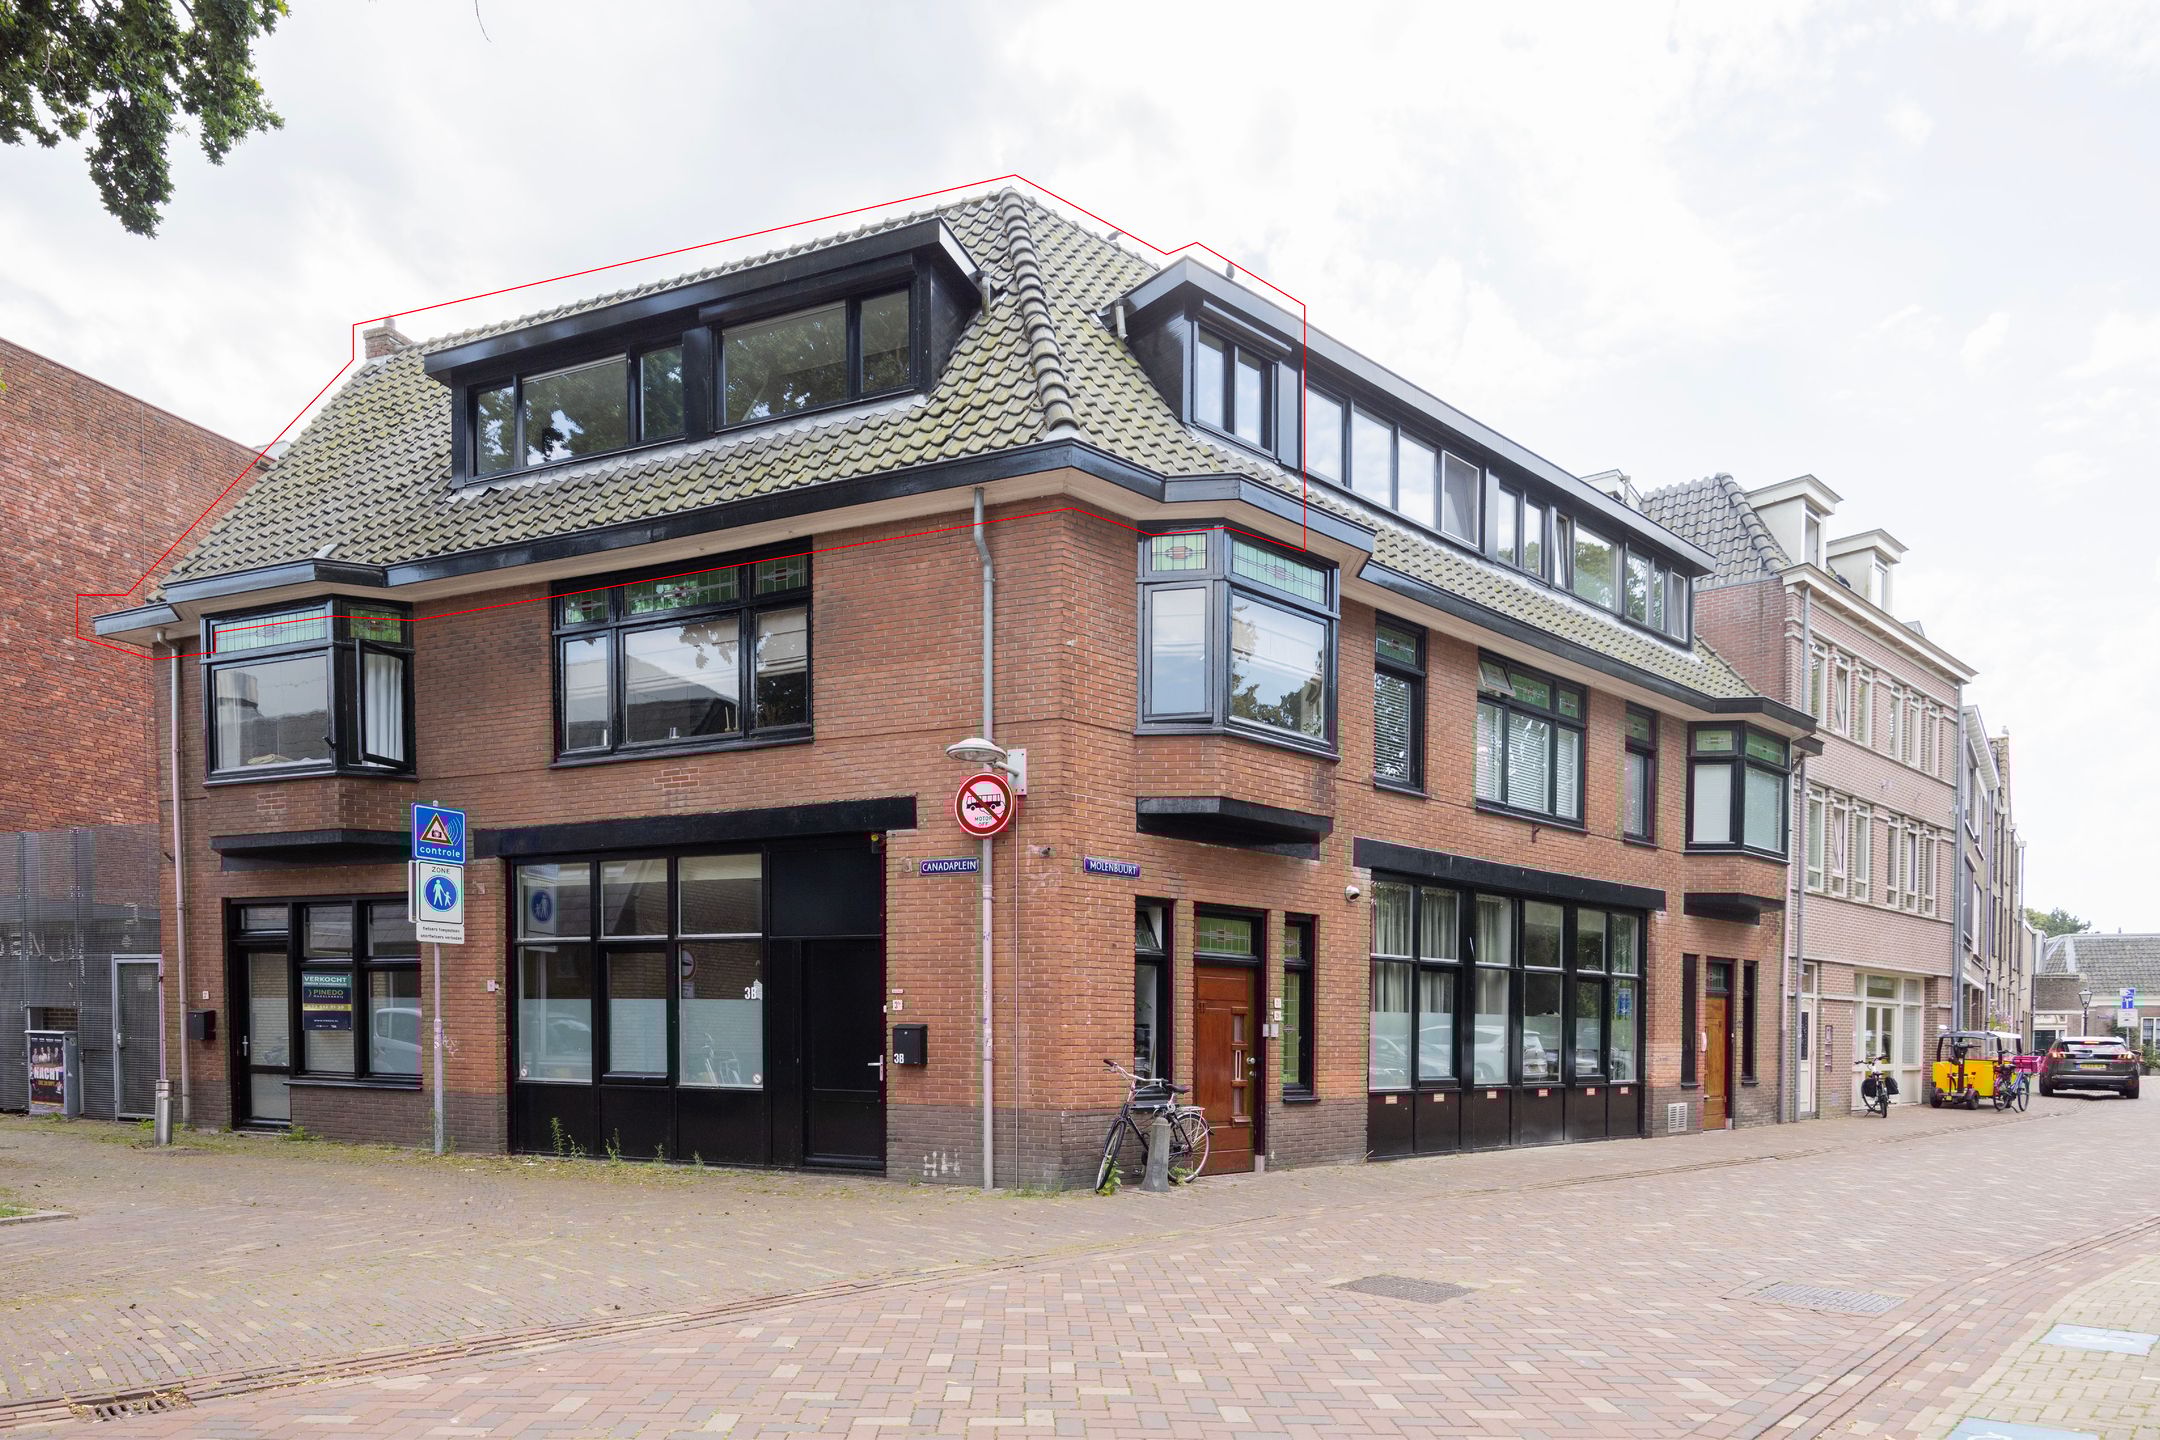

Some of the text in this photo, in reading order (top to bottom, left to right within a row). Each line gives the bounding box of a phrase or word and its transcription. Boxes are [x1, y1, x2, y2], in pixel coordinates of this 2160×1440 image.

[420, 847, 460, 857] controle
[432, 866, 450, 874] ZONE
[922, 861, 976, 872] CANADAPLEIN
[1090, 860, 1136, 875] MOLENBUURT
[744, 986, 756, 999] 3B
[894, 1053, 904, 1064] 3B
[33, 1066, 62, 1081] NACHT
